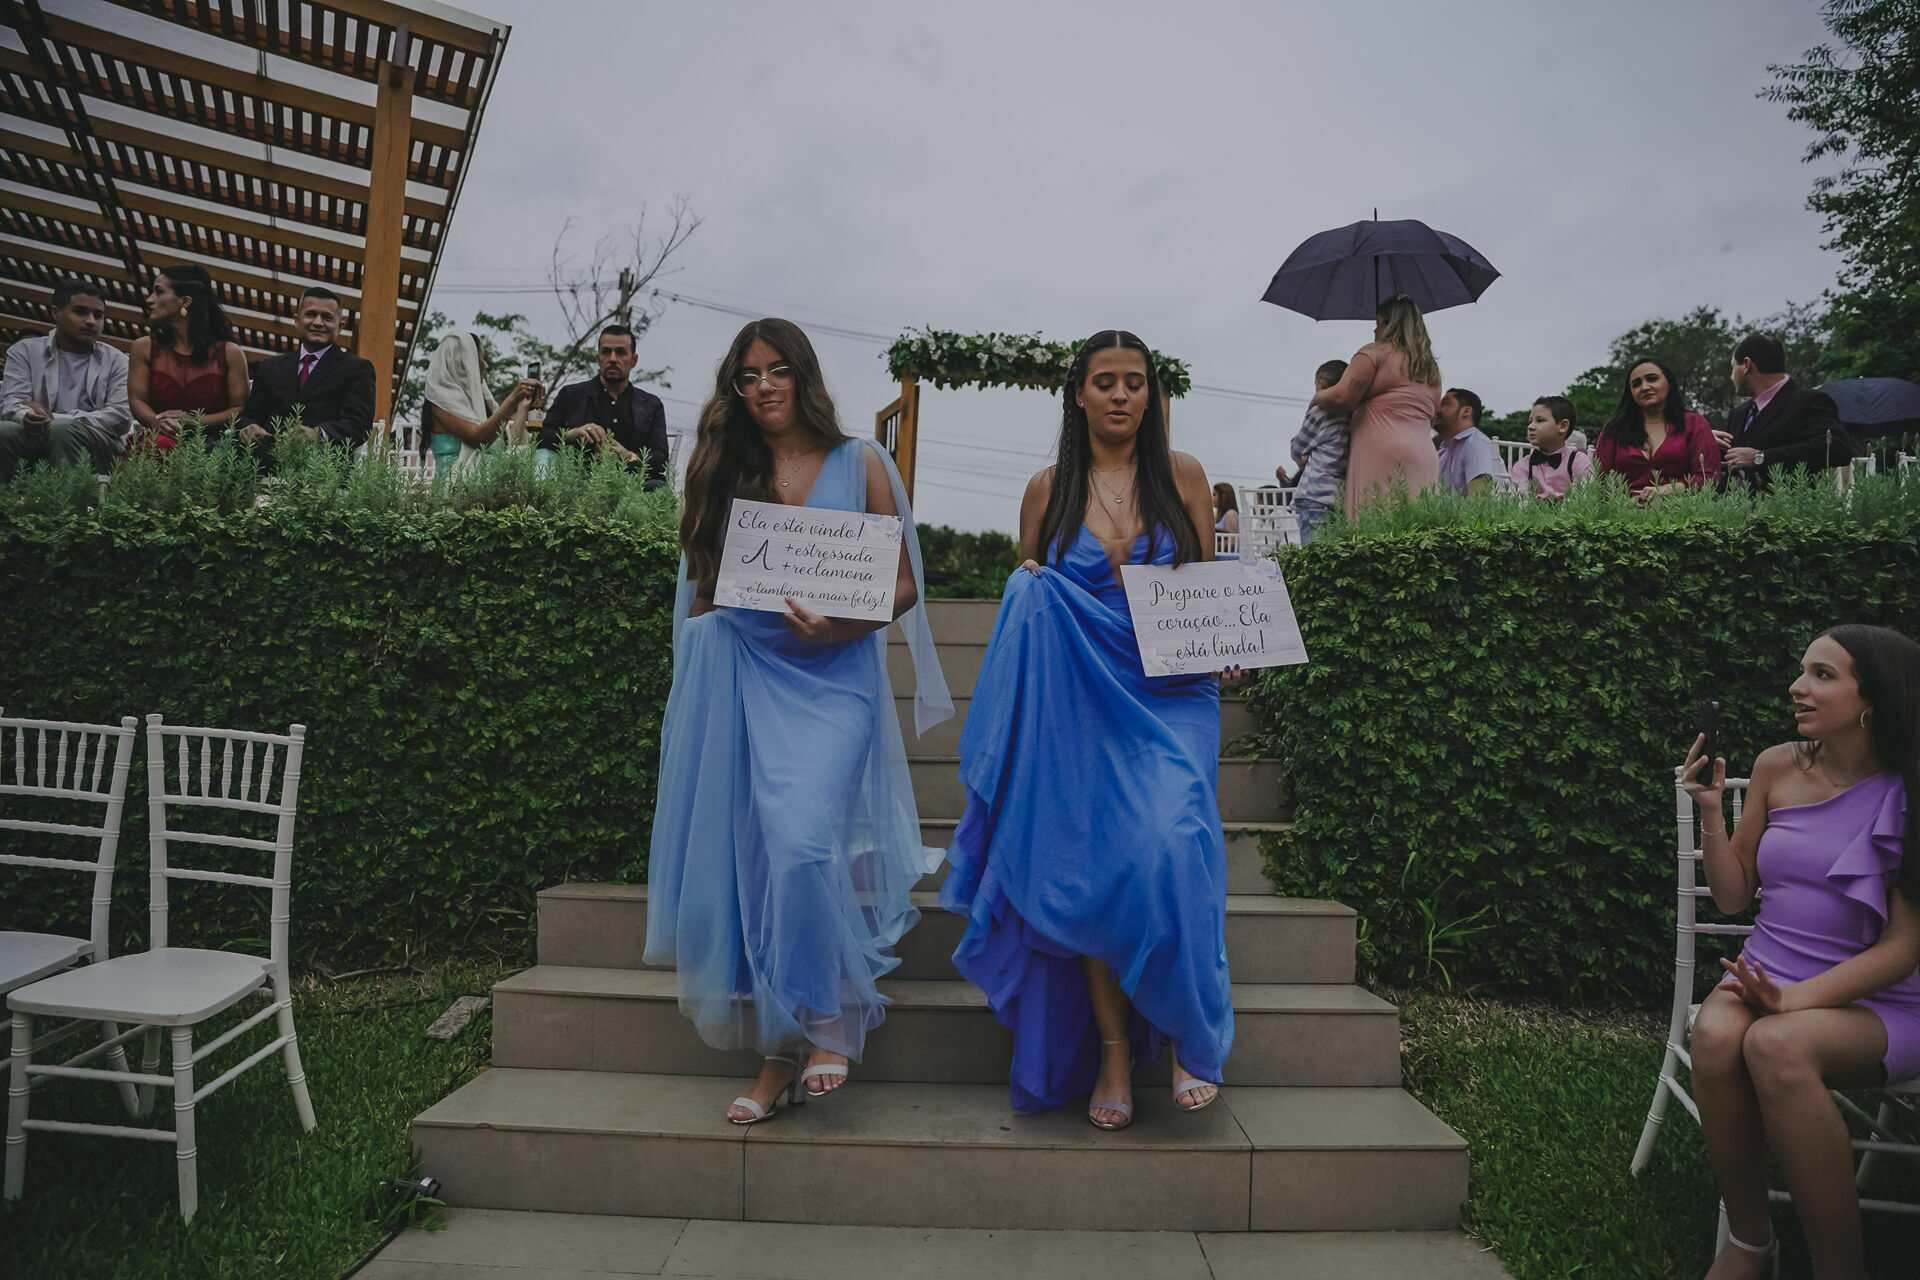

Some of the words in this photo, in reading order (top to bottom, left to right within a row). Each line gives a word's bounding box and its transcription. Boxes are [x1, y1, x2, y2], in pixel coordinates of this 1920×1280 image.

[738, 511, 770, 529] Ela
[773, 518, 805, 534] está
[810, 522, 865, 540] vindo!
[742, 539, 774, 570] A
[747, 585, 754, 593] e
[755, 581, 805, 598] também
[808, 591, 817, 599] a
[819, 591, 849, 601] mais
[850, 590, 886, 611] feliz!
[1149, 581, 1220, 611] Prepare
[1224, 586, 1234, 597] o
[1239, 583, 1265, 596] seu
[1157, 615, 1236, 632] coração...
[1239, 601, 1271, 627] Ela
[1176, 640, 1210, 660] está
[1213, 630, 1266, 657] linda!
